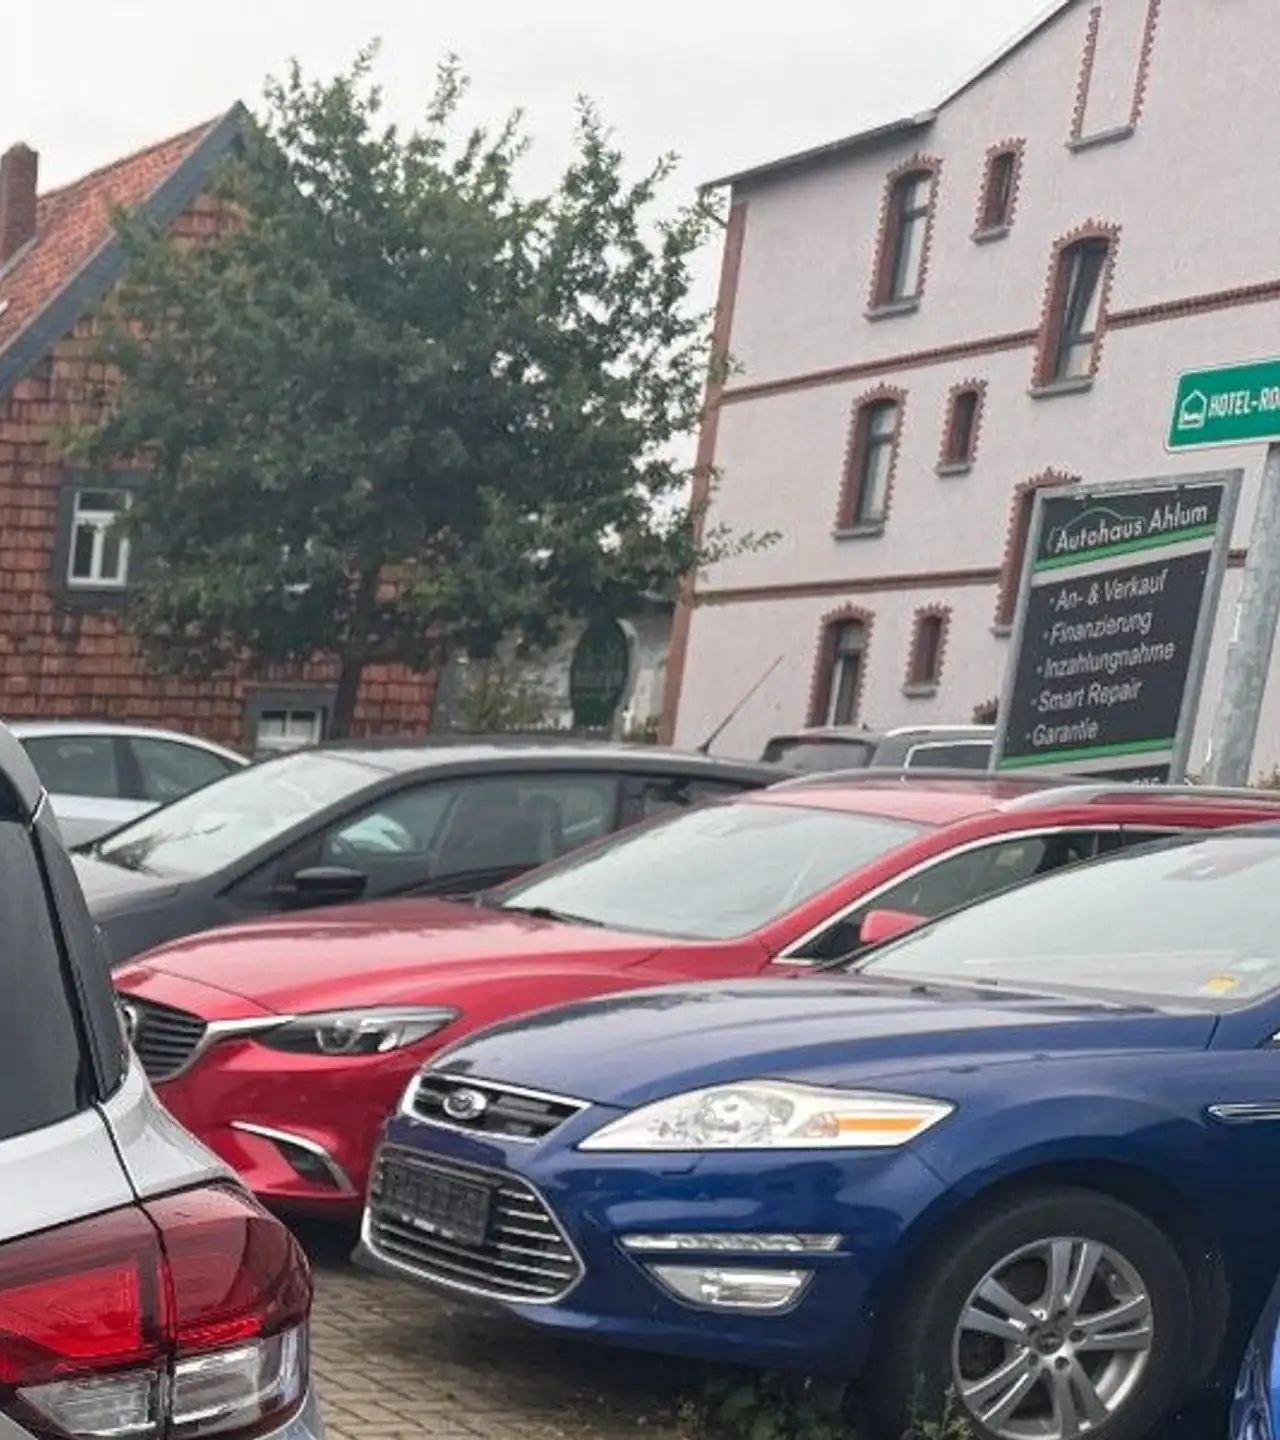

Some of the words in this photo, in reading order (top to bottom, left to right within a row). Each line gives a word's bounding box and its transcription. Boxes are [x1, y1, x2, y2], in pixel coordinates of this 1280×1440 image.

[1055, 518, 1142, 553] Autohaus
[1147, 501, 1208, 534] Ahlum
[1054, 588, 1083, 612] An-
[1087, 582, 1100, 607] &
[1104, 568, 1169, 603] Verkauf
[1049, 610, 1154, 646] Finanzierung
[1044, 641, 1176, 679] Inzahlungnahme
[1038, 686, 1085, 712] Smart
[1087, 676, 1143, 707] Repair
[1032, 716, 1100, 746] Garantie
